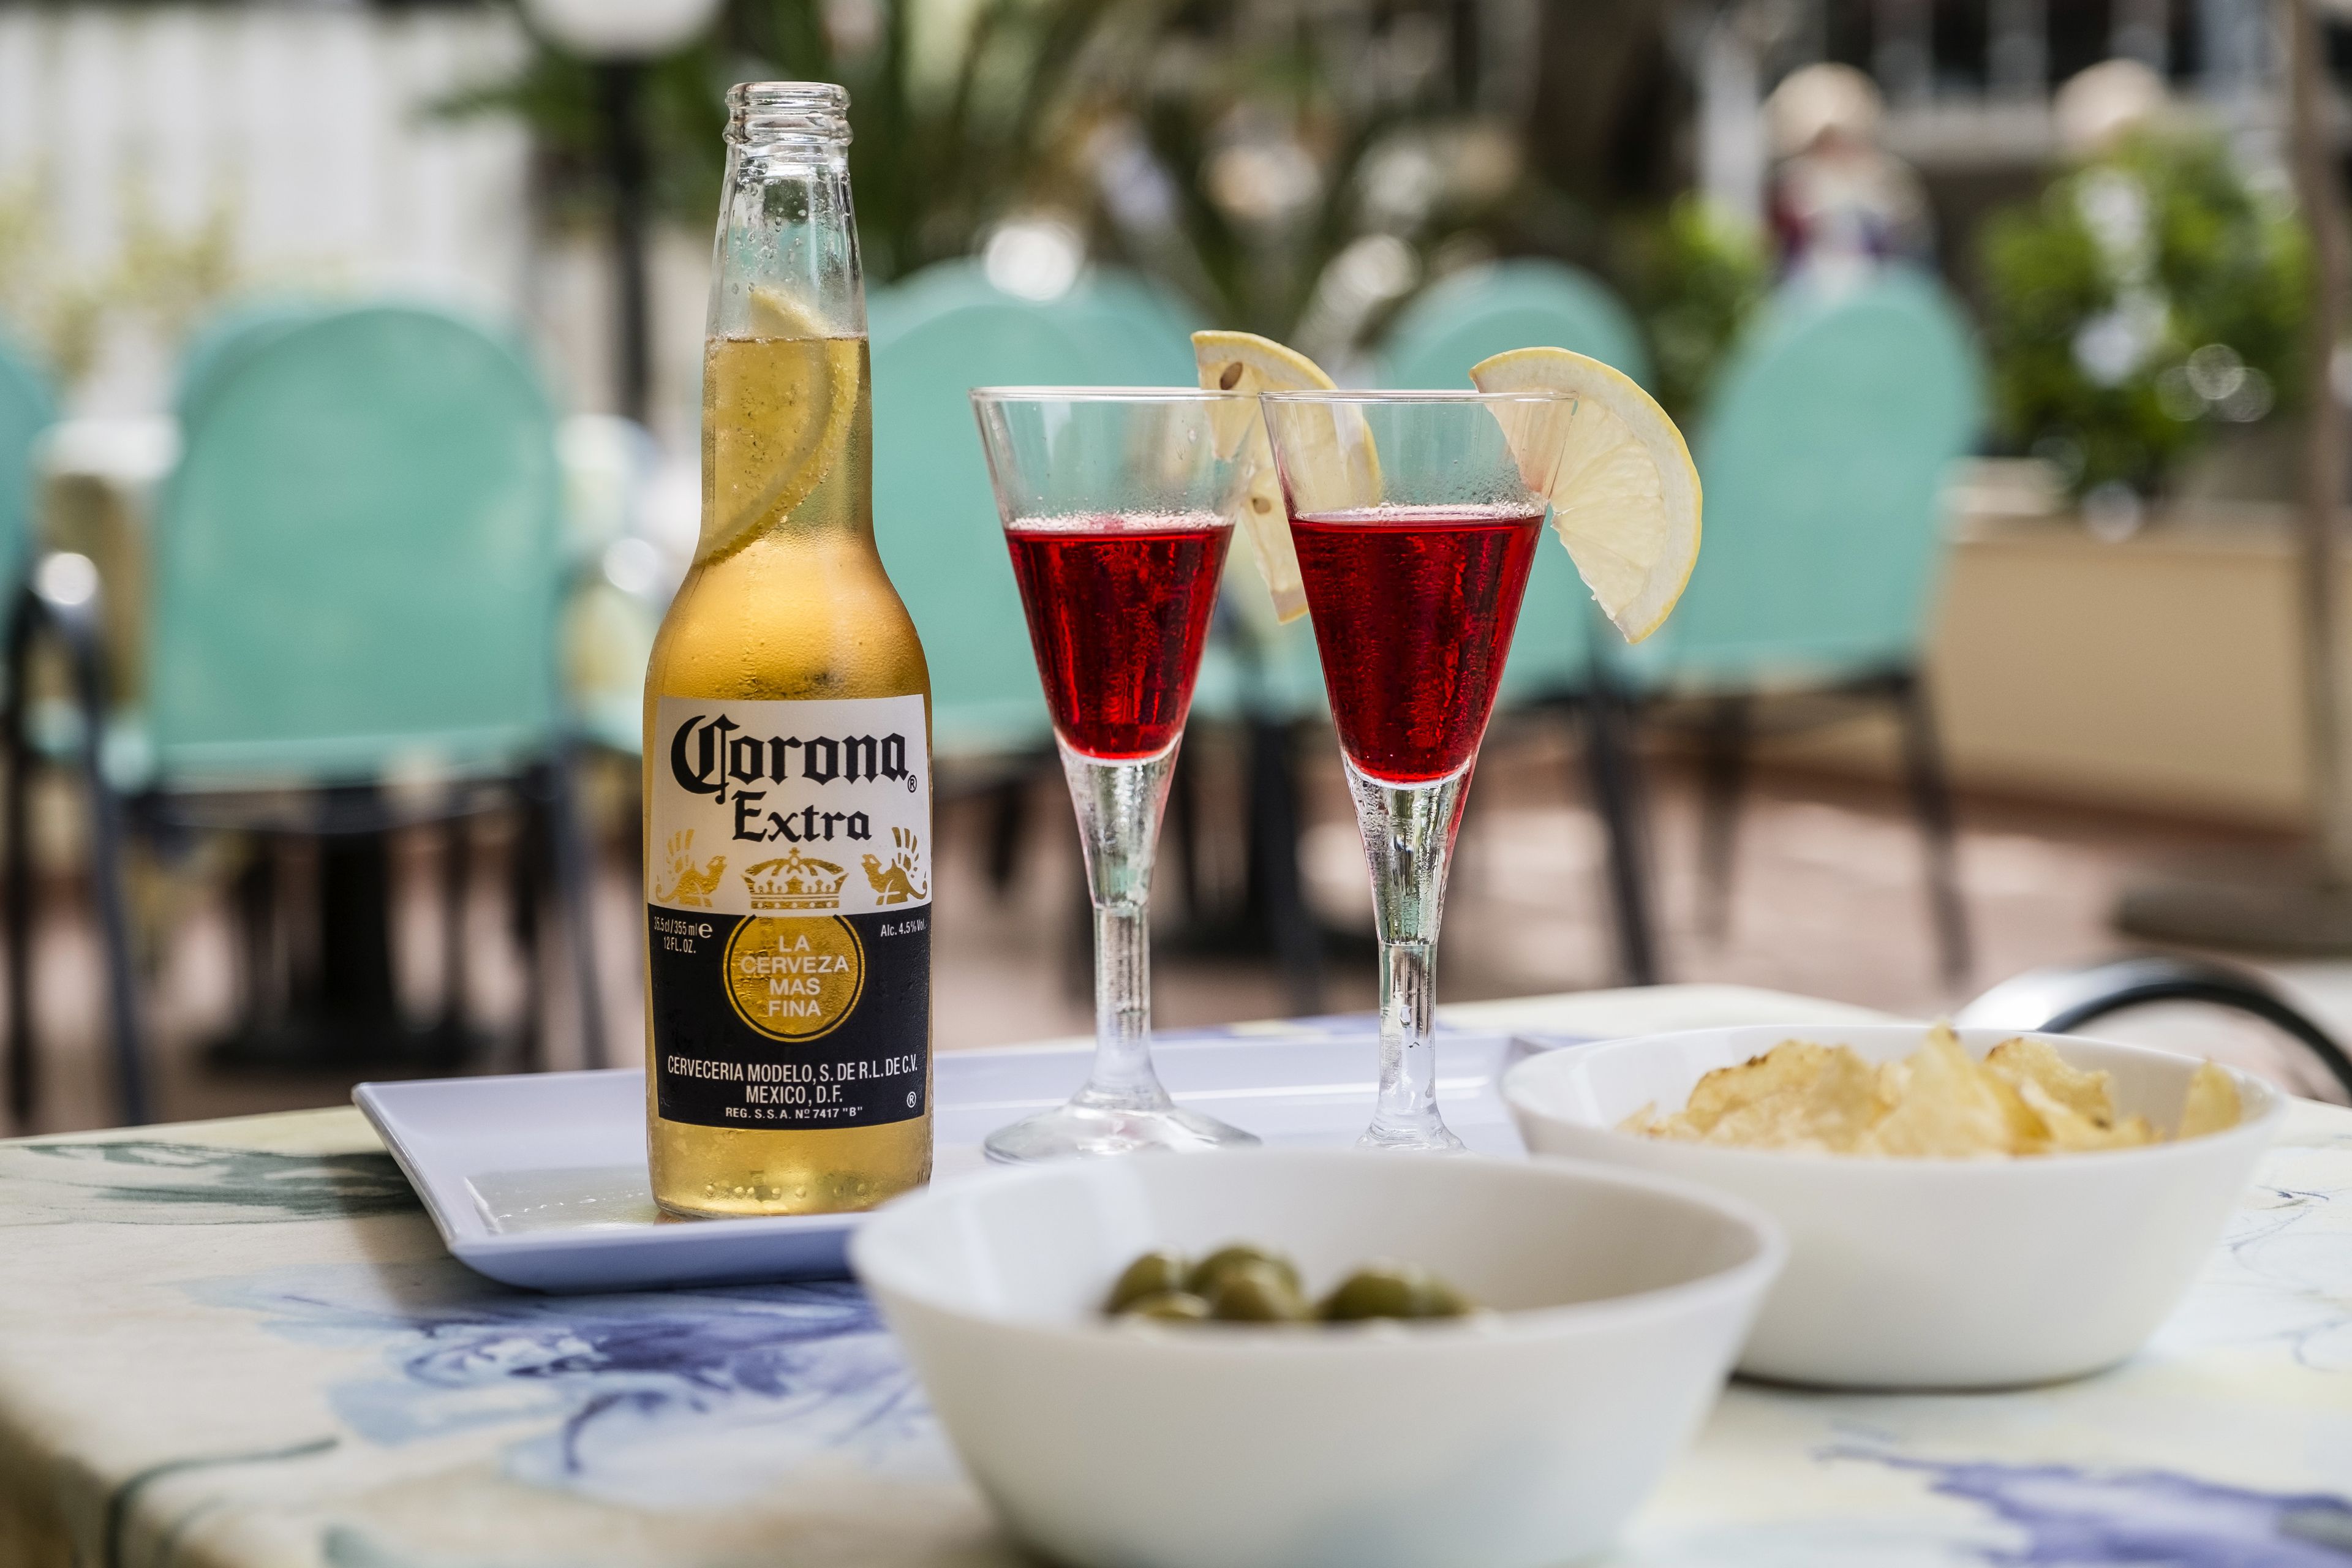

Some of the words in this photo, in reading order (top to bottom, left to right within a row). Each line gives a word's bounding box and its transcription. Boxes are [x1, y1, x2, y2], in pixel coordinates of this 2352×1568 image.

[671, 714, 909, 804] Corona
[731, 790, 872, 842] Extra
[880, 924, 897, 937] Alc.
[778, 935, 810, 952] LA
[740, 955, 850, 974] CERVEZA
[769, 978, 821, 995] MAS
[768, 1000, 822, 1017] FINA
[668, 1055, 744, 1082] CERVECERIA
[747, 1063, 816, 1085] MODELO,
[820, 1064, 834, 1082] S.
[837, 1062, 855, 1081] DE
[859, 1060, 884, 1079] R.L.
[886, 1057, 900, 1076] DE
[902, 1054, 918, 1074] C.V.
[746, 1085, 812, 1107] MEXICO,
[816, 1085, 843, 1103] D.F.
[725, 1107, 752, 1118] REG.
[812, 1108, 840, 1119] 7417
